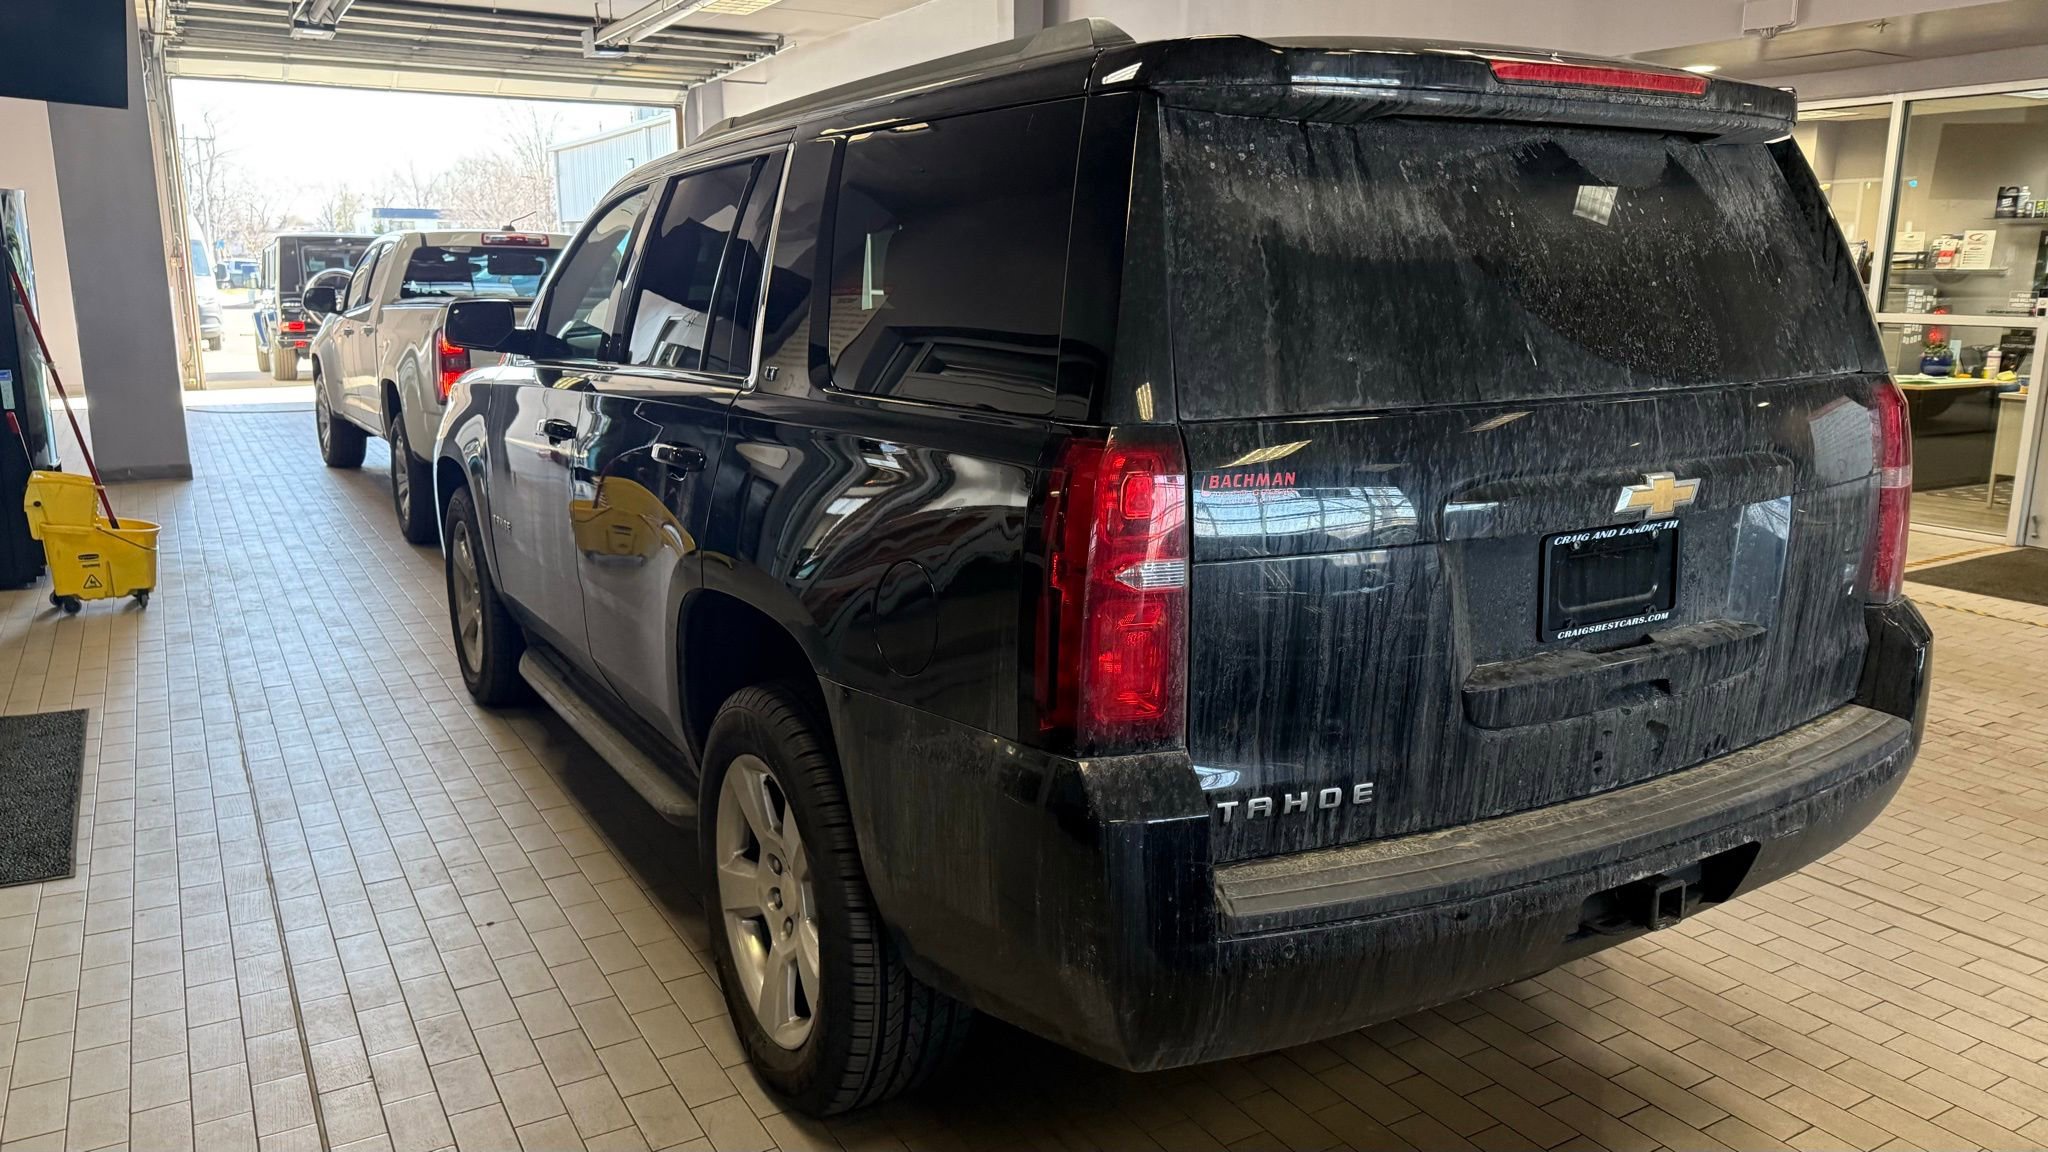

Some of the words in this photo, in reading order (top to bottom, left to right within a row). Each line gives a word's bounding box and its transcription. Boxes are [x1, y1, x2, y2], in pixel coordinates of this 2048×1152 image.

[1209, 472, 1296, 489] BACHMAN
[1554, 533, 1590, 545] CRAIG
[1591, 528, 1618, 540] AND
[1557, 612, 1669, 640] CRAIGSBESTCARS.COM
[1217, 782, 1374, 823] TAHOE
